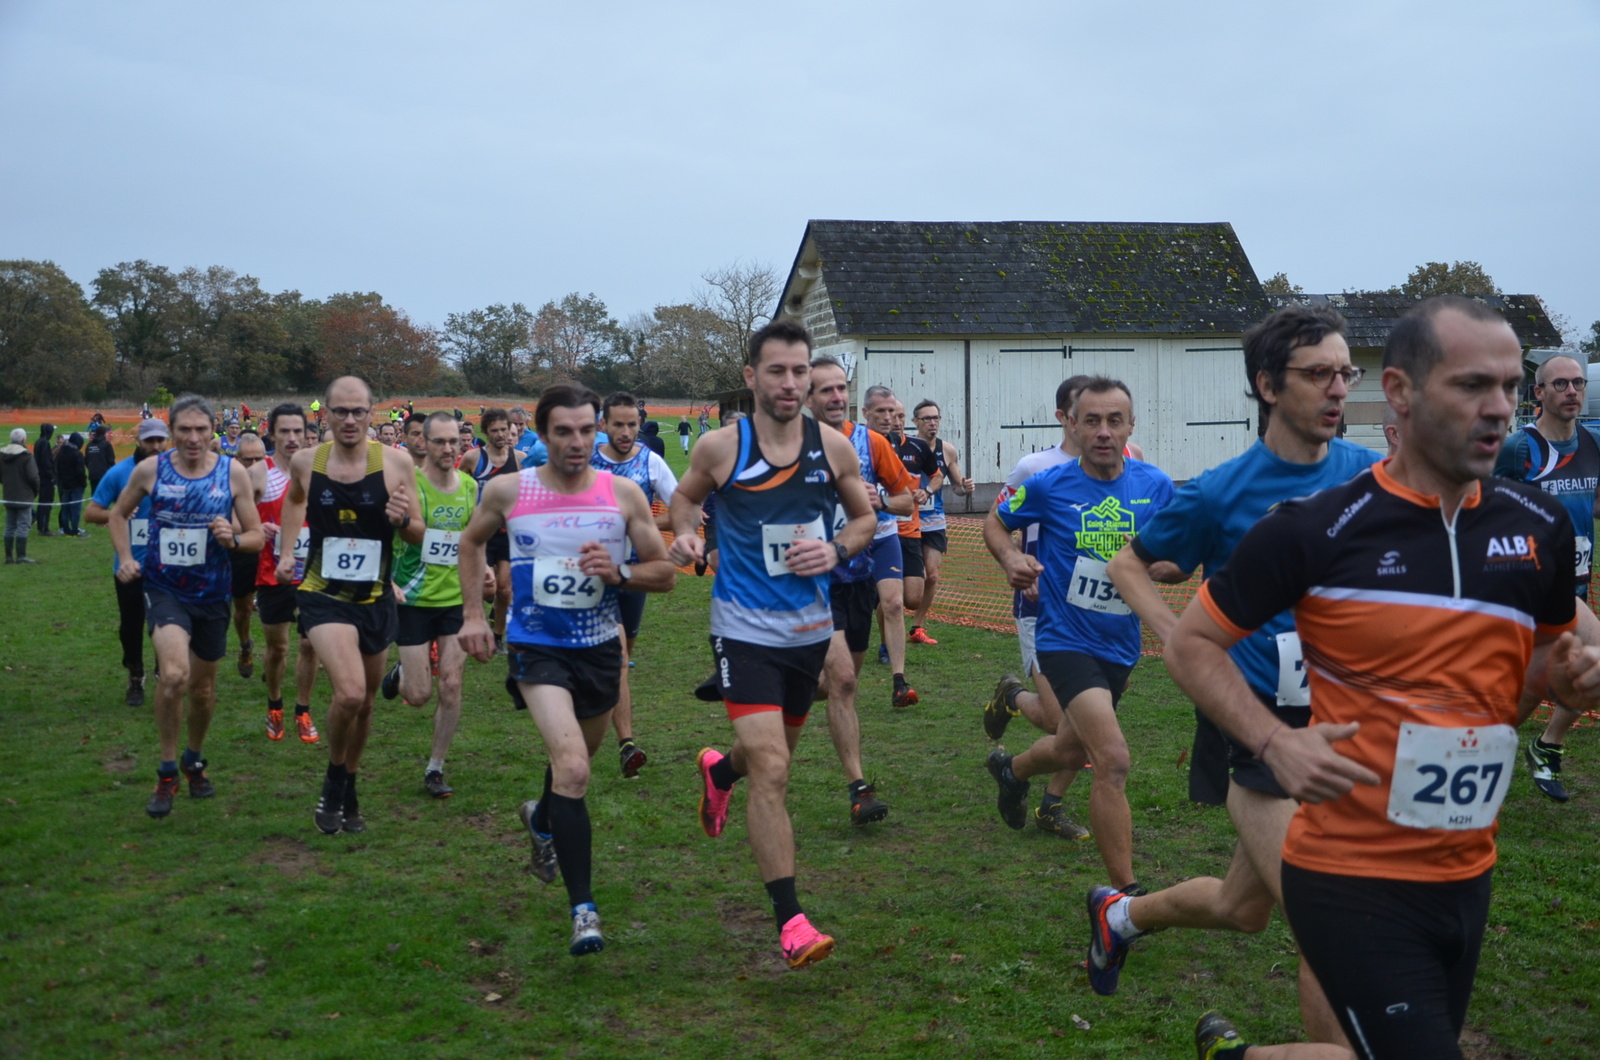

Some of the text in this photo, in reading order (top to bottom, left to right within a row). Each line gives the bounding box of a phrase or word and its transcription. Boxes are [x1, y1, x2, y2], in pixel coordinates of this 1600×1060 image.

[168, 541, 198, 557] 916
[429, 541, 459, 557] 579
[1486, 535, 1529, 557] ALB
[337, 553, 366, 571] 87
[1376, 565, 1407, 576] SKILLS
[543, 574, 597, 597] 624
[720, 656, 731, 688] PRO
[1413, 762, 1504, 805] 267
[1448, 815, 1473, 825] M2H
